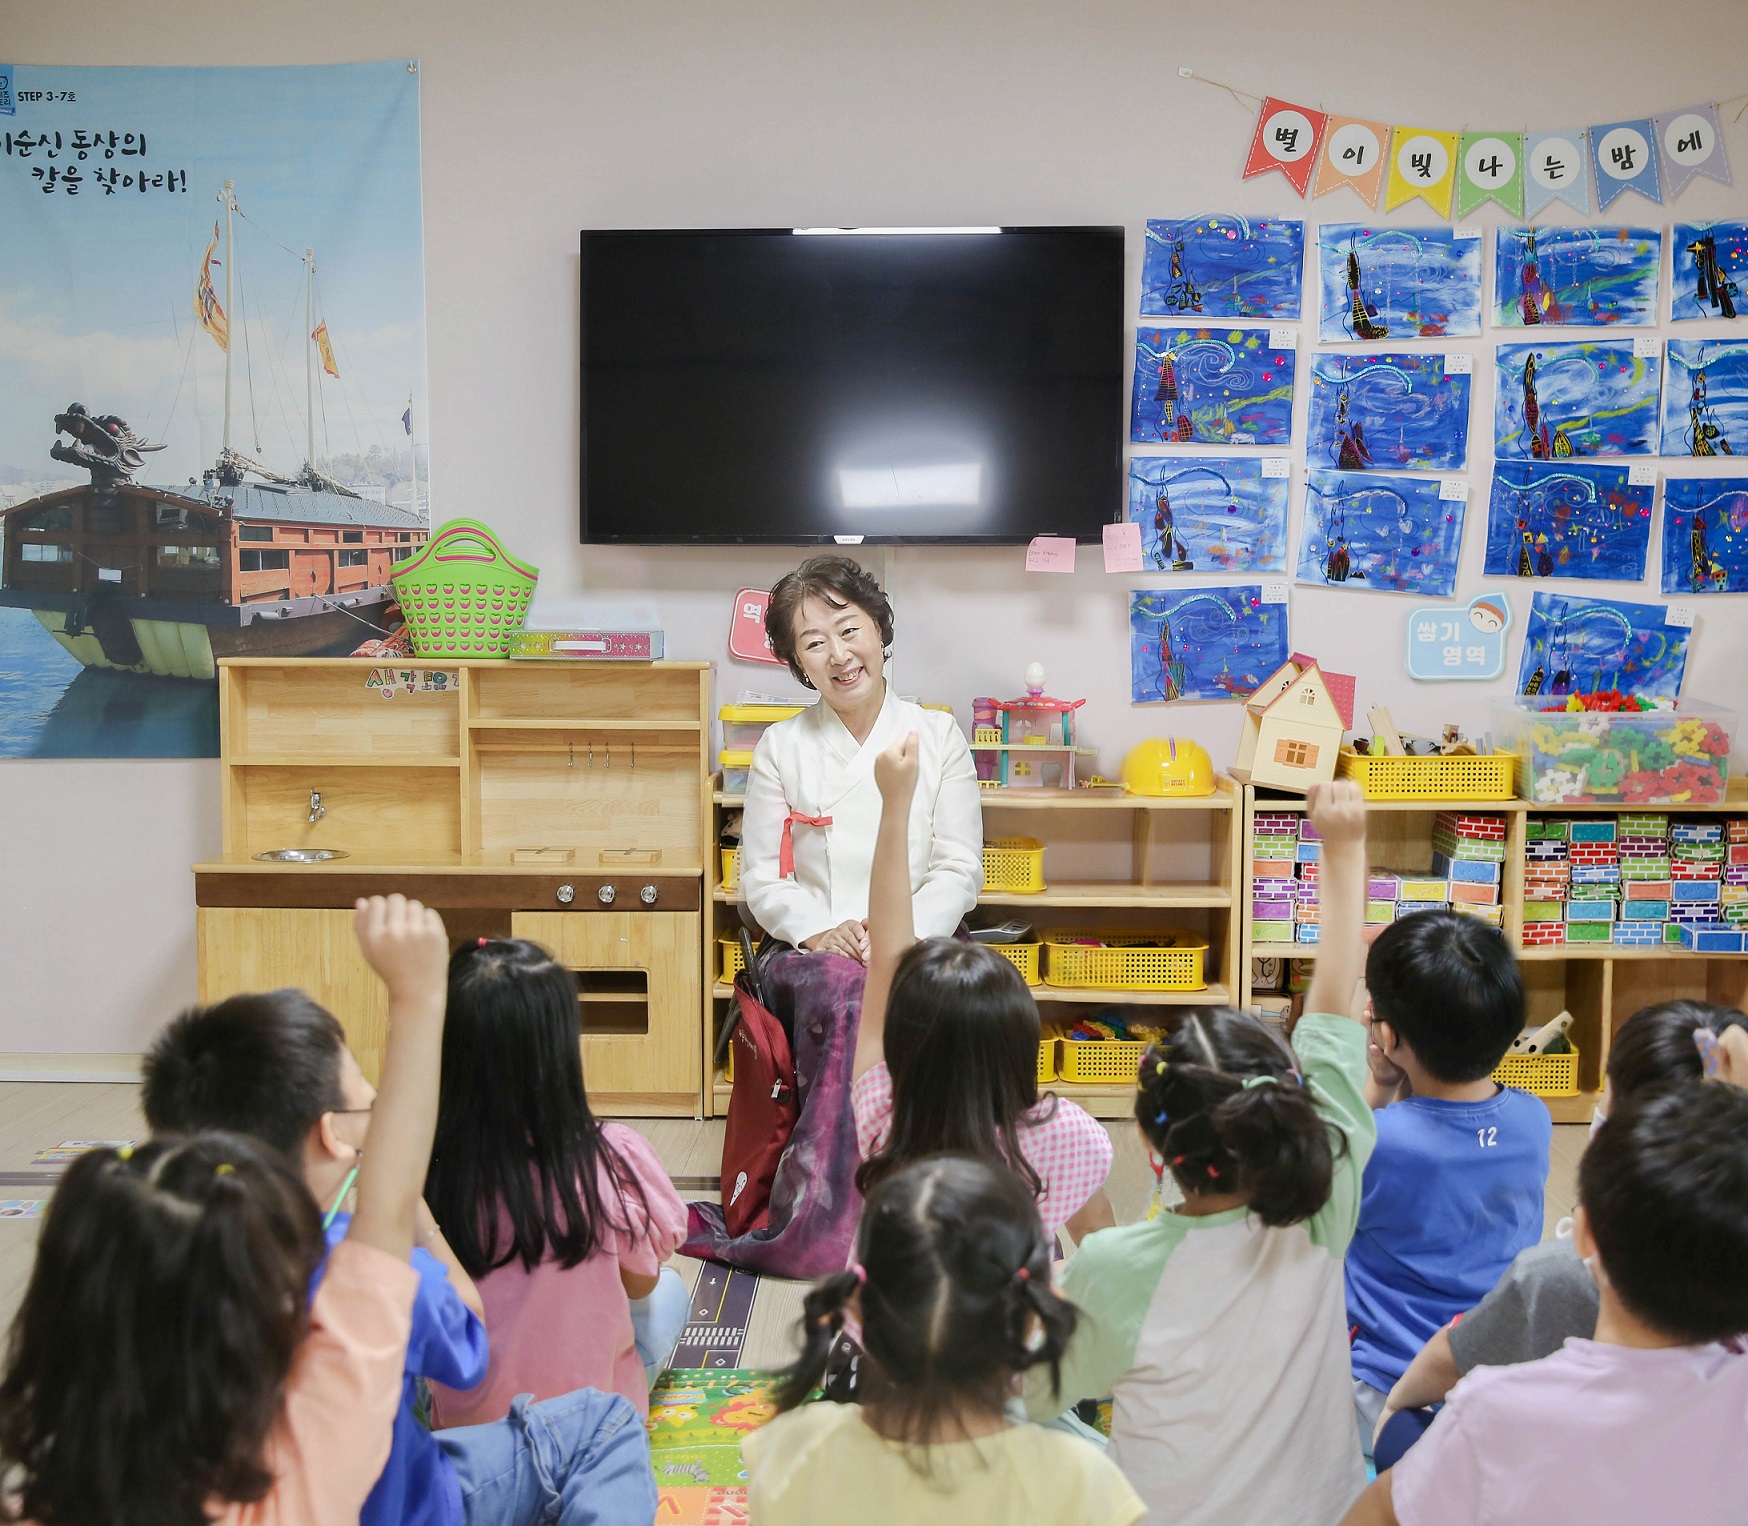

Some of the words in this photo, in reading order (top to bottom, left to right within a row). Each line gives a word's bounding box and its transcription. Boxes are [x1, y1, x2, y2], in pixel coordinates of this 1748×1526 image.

[17, 91, 43, 102] STEP
[45, 91, 77, 102] 3-7호
[70, 129, 148, 161] 동상의
[1275, 127, 1299, 153] 별
[1342, 145, 1365, 165] 이
[1411, 153, 1432, 178] 빛
[1478, 155, 1504, 177] 나
[1543, 155, 1565, 180] 는
[1611, 144, 1637, 171] 밤
[1677, 129, 1703, 153] 에
[30, 165, 84, 196] 칼을
[92, 167, 188, 196] 찾아라!
[743, 603, 762, 624] 역
[1417, 622, 1460, 642] 쌓기
[1442, 646, 1485, 666] 영역
[1477, 1126, 1497, 1148] 12
